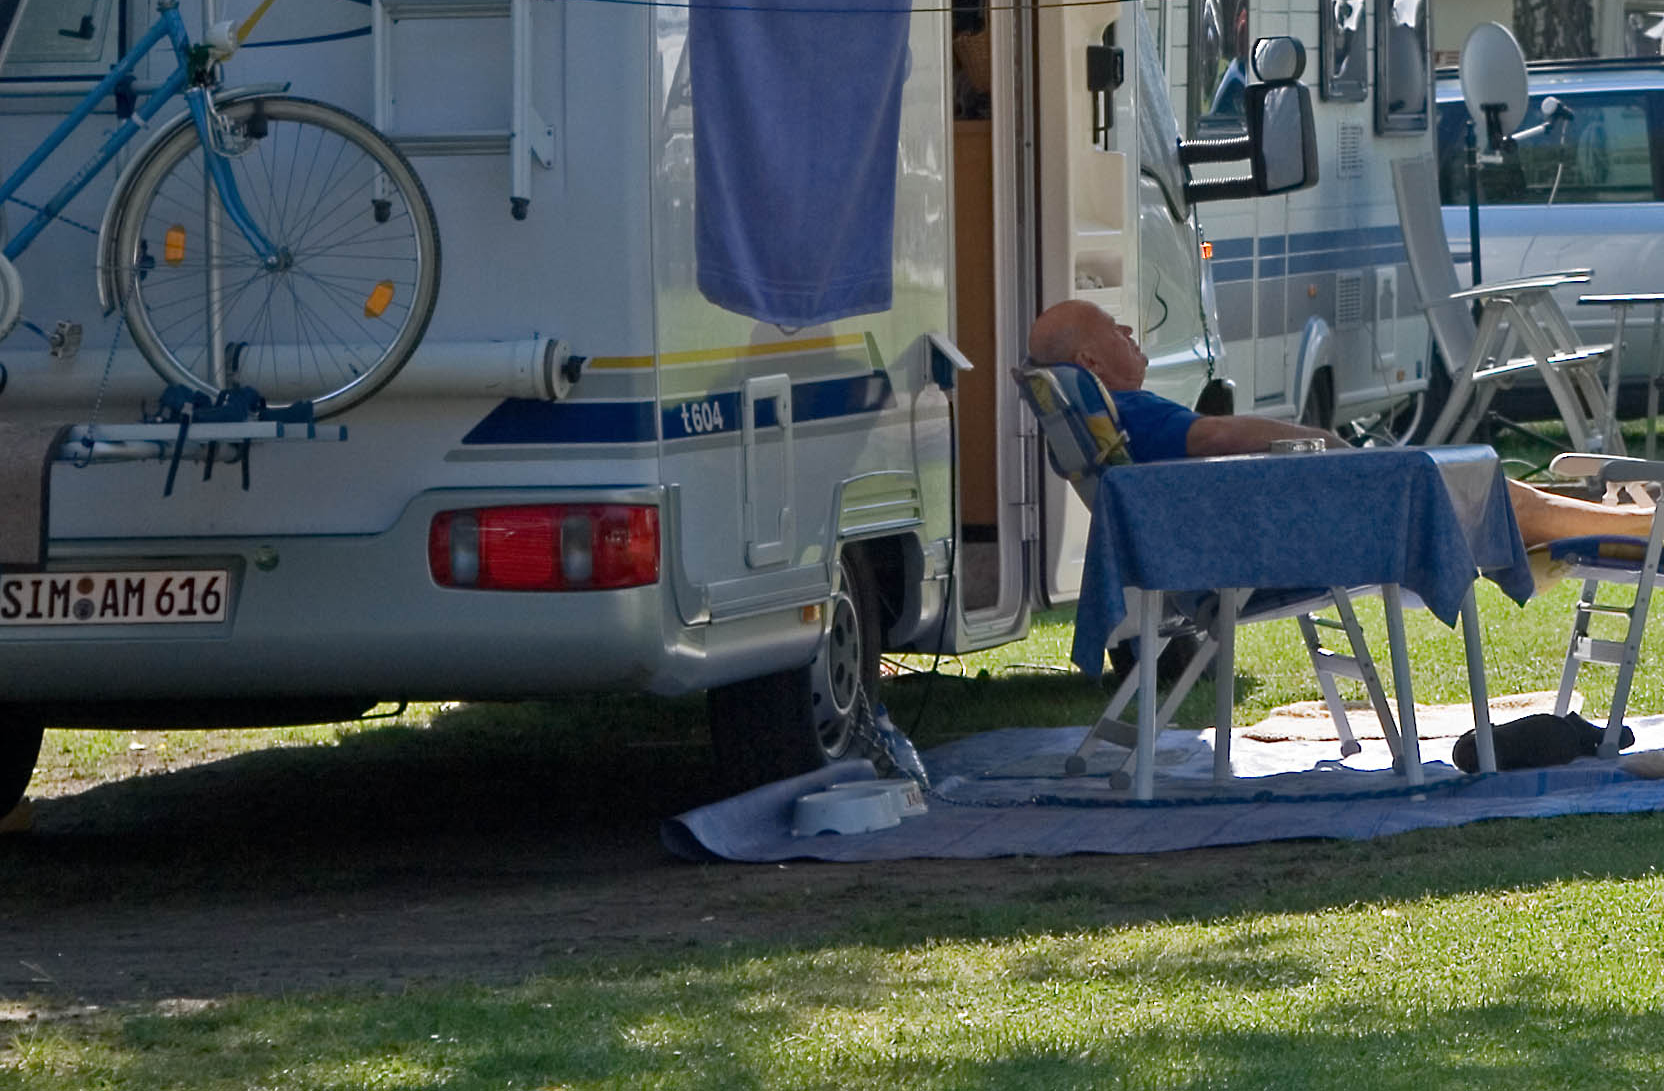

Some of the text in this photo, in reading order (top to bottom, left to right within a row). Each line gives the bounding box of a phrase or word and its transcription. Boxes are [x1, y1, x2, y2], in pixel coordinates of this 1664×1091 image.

[682, 402, 723, 433] t604
[1, 576, 221, 619] SIM AM 616
